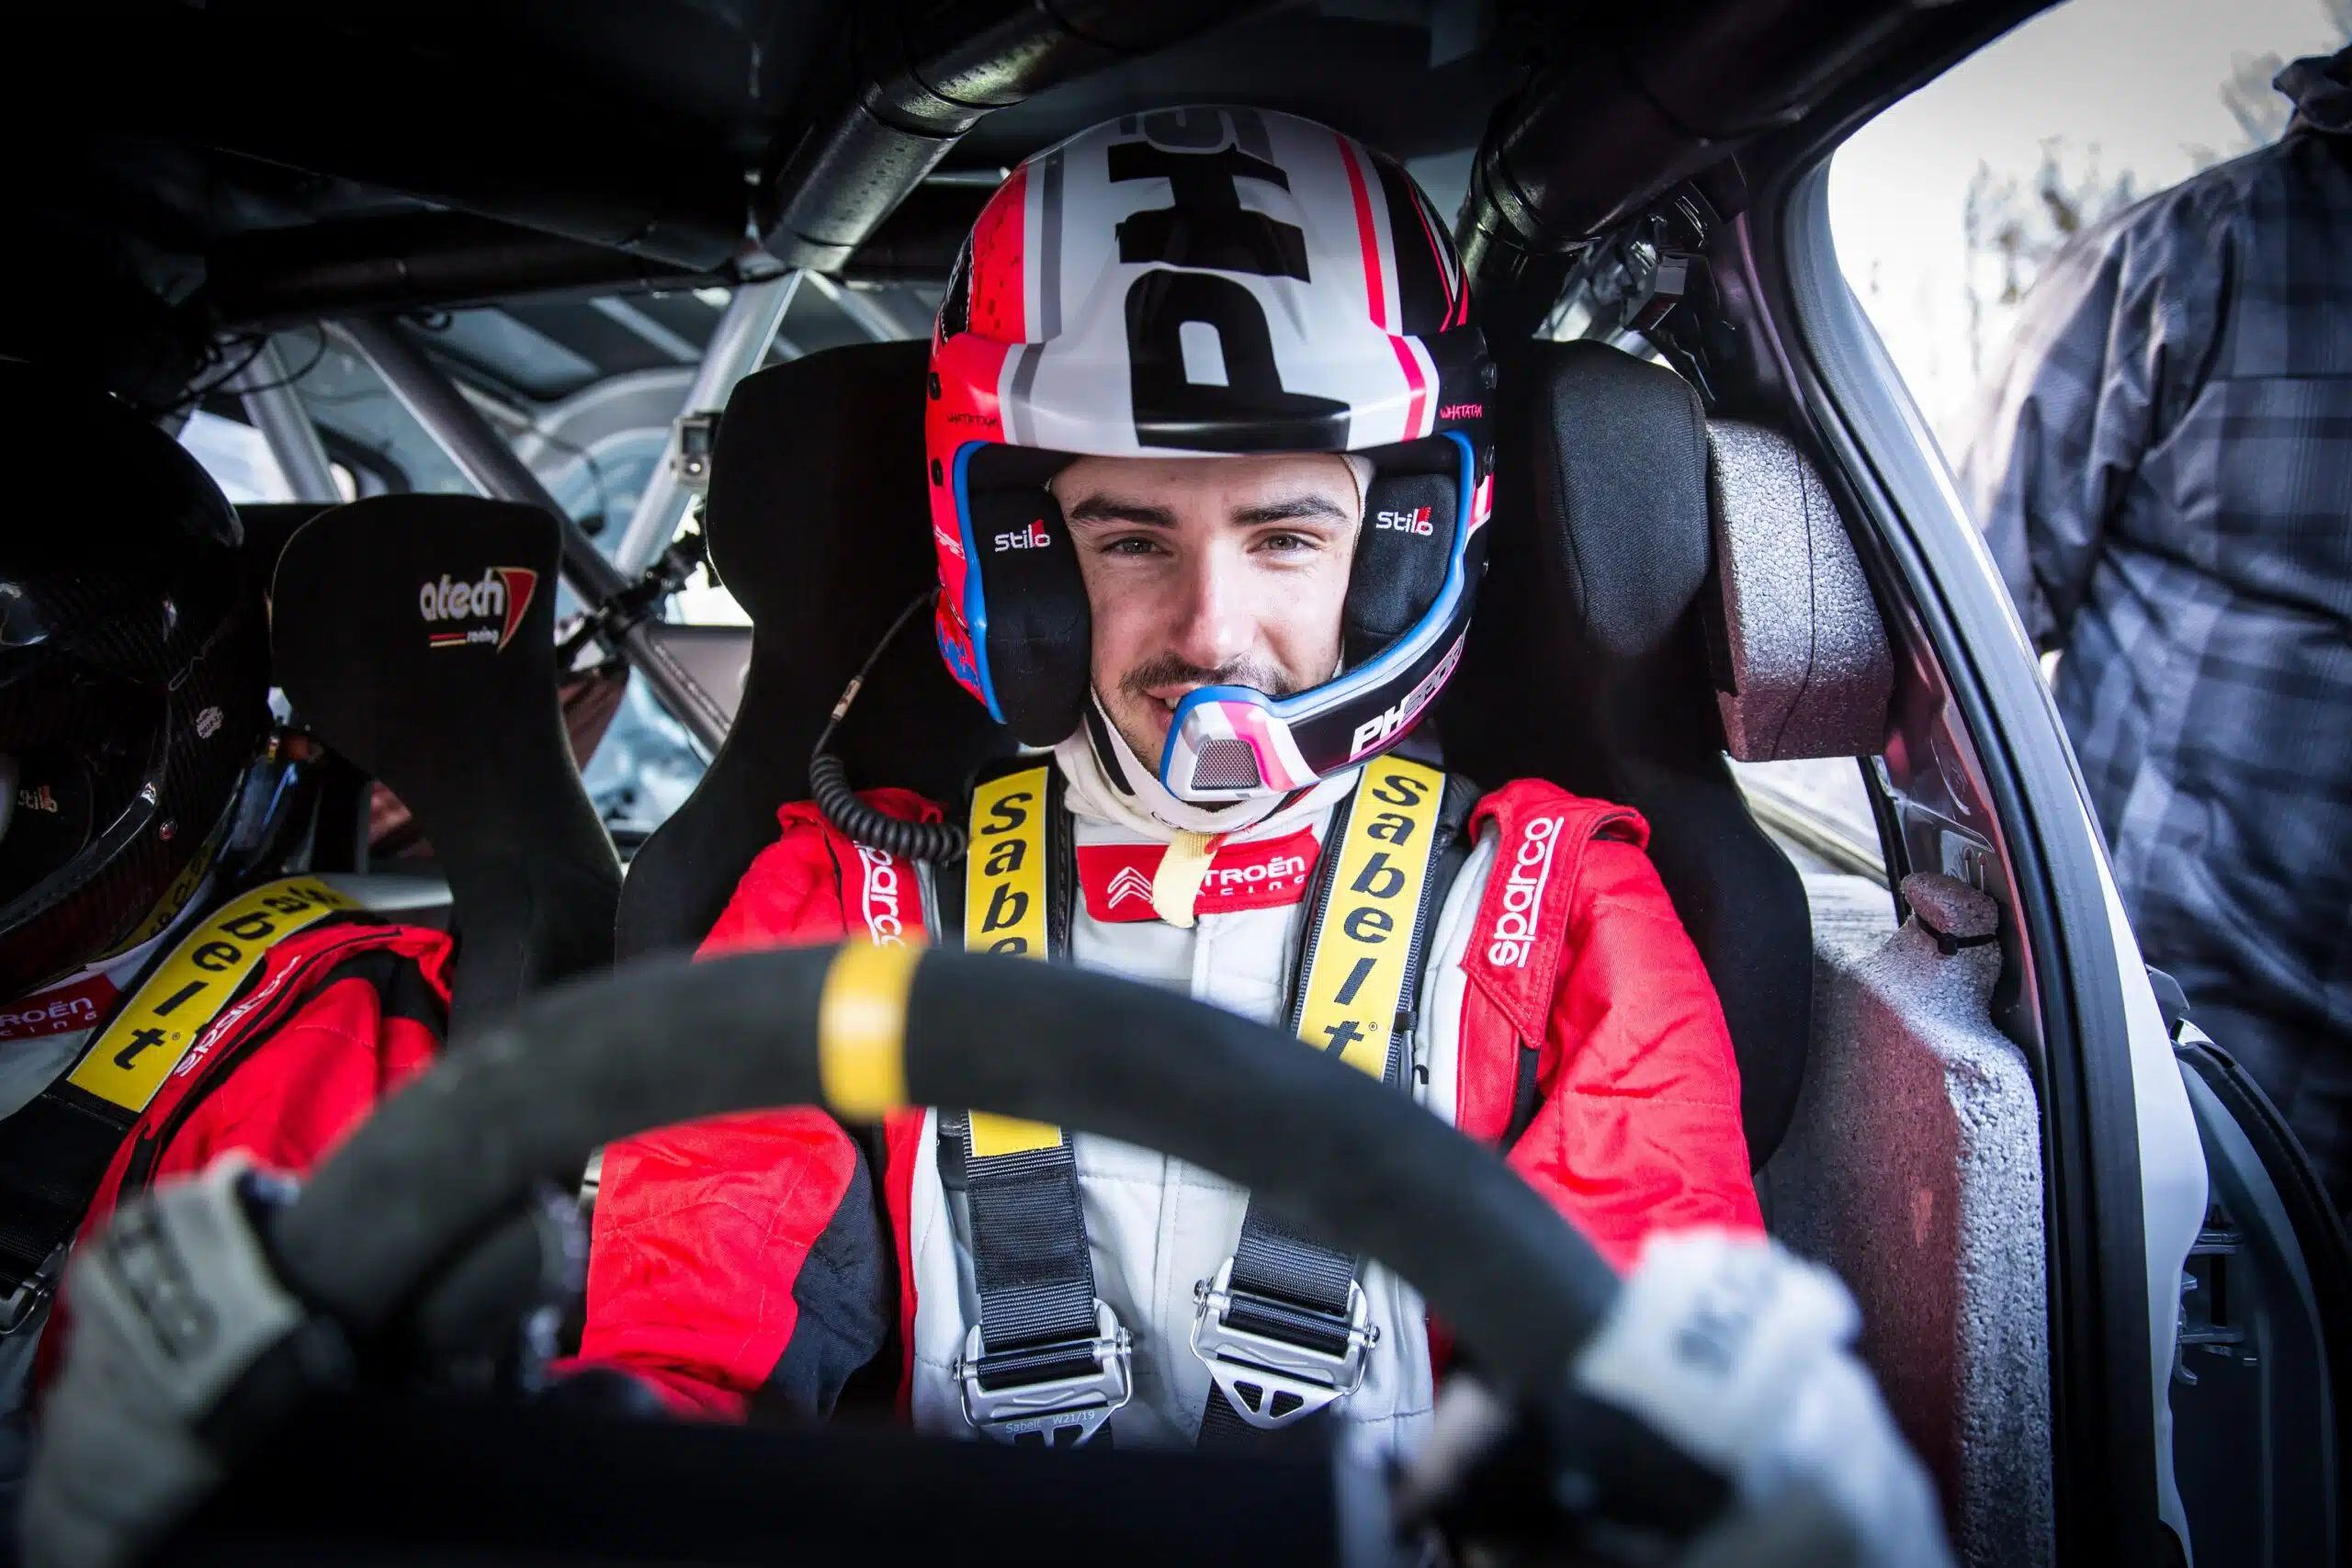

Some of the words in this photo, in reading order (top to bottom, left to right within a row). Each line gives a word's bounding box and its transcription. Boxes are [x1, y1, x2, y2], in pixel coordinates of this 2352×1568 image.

[420, 567, 504, 622] atech
[865, 844, 905, 947] parc
[1487, 816, 1556, 967] sparco
[1005, 1420, 1042, 1434] Sabelt
